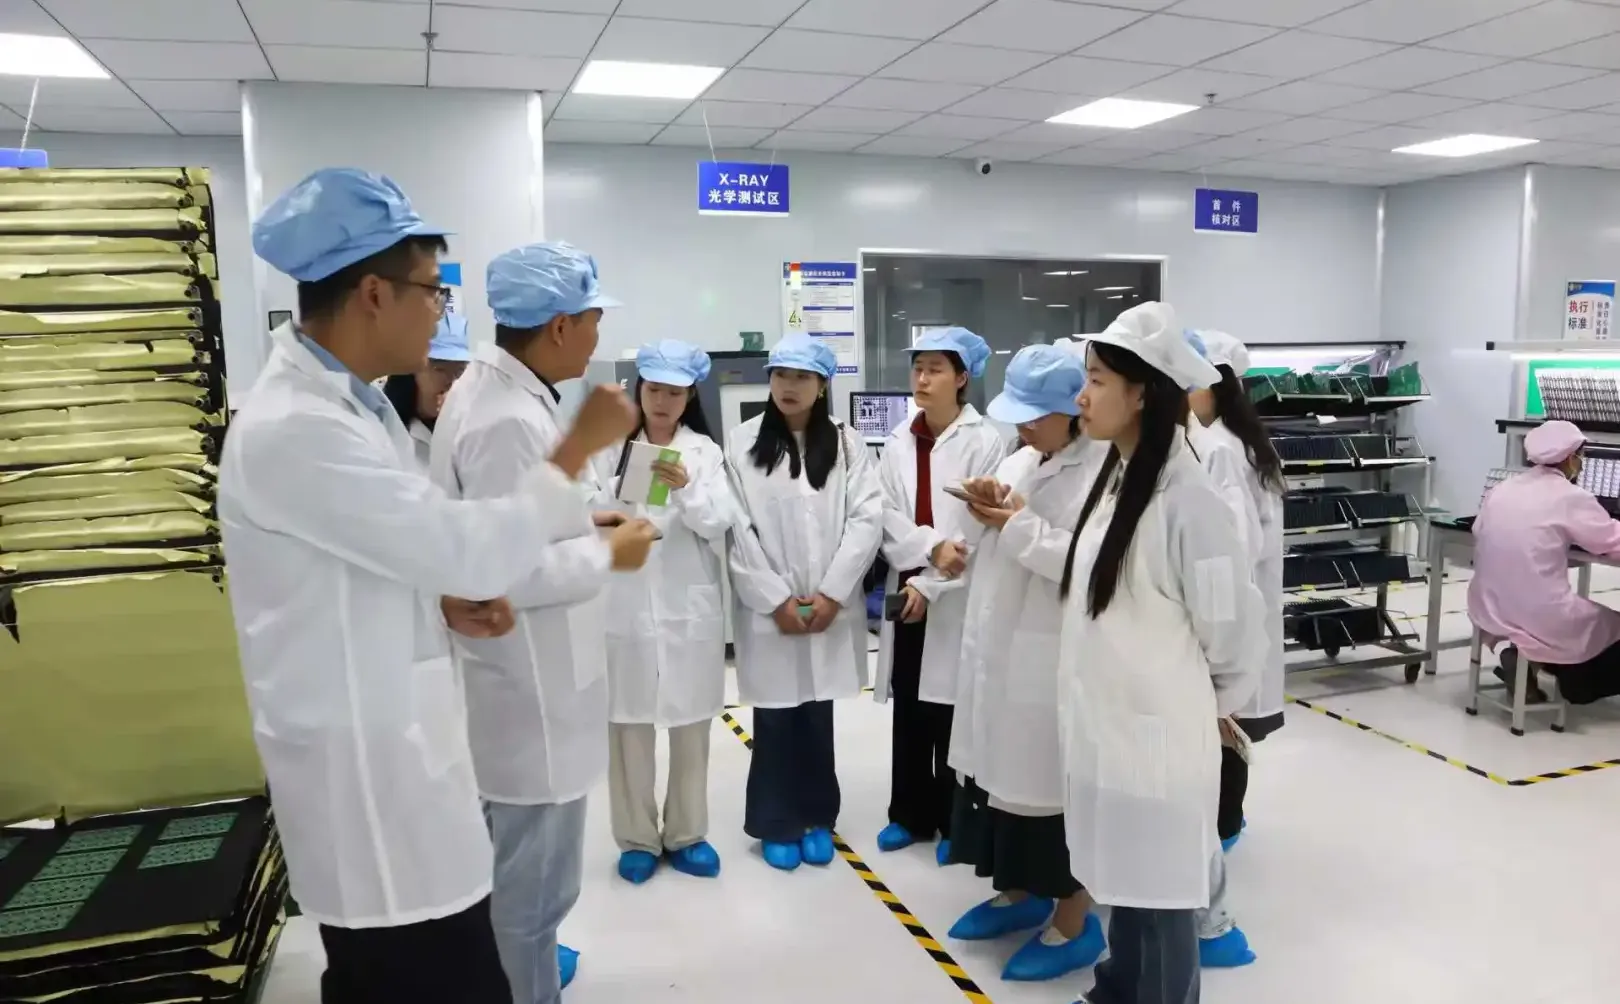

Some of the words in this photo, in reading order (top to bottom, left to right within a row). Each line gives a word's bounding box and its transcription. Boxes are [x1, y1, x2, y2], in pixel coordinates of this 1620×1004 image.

[719, 173, 769, 186] X-RAY
[708, 189, 780, 205] 光学测试区
[1212, 213, 1240, 226] 核对区
[1569, 300, 1588, 313] 执行
[1568, 317, 1587, 330] 标准
